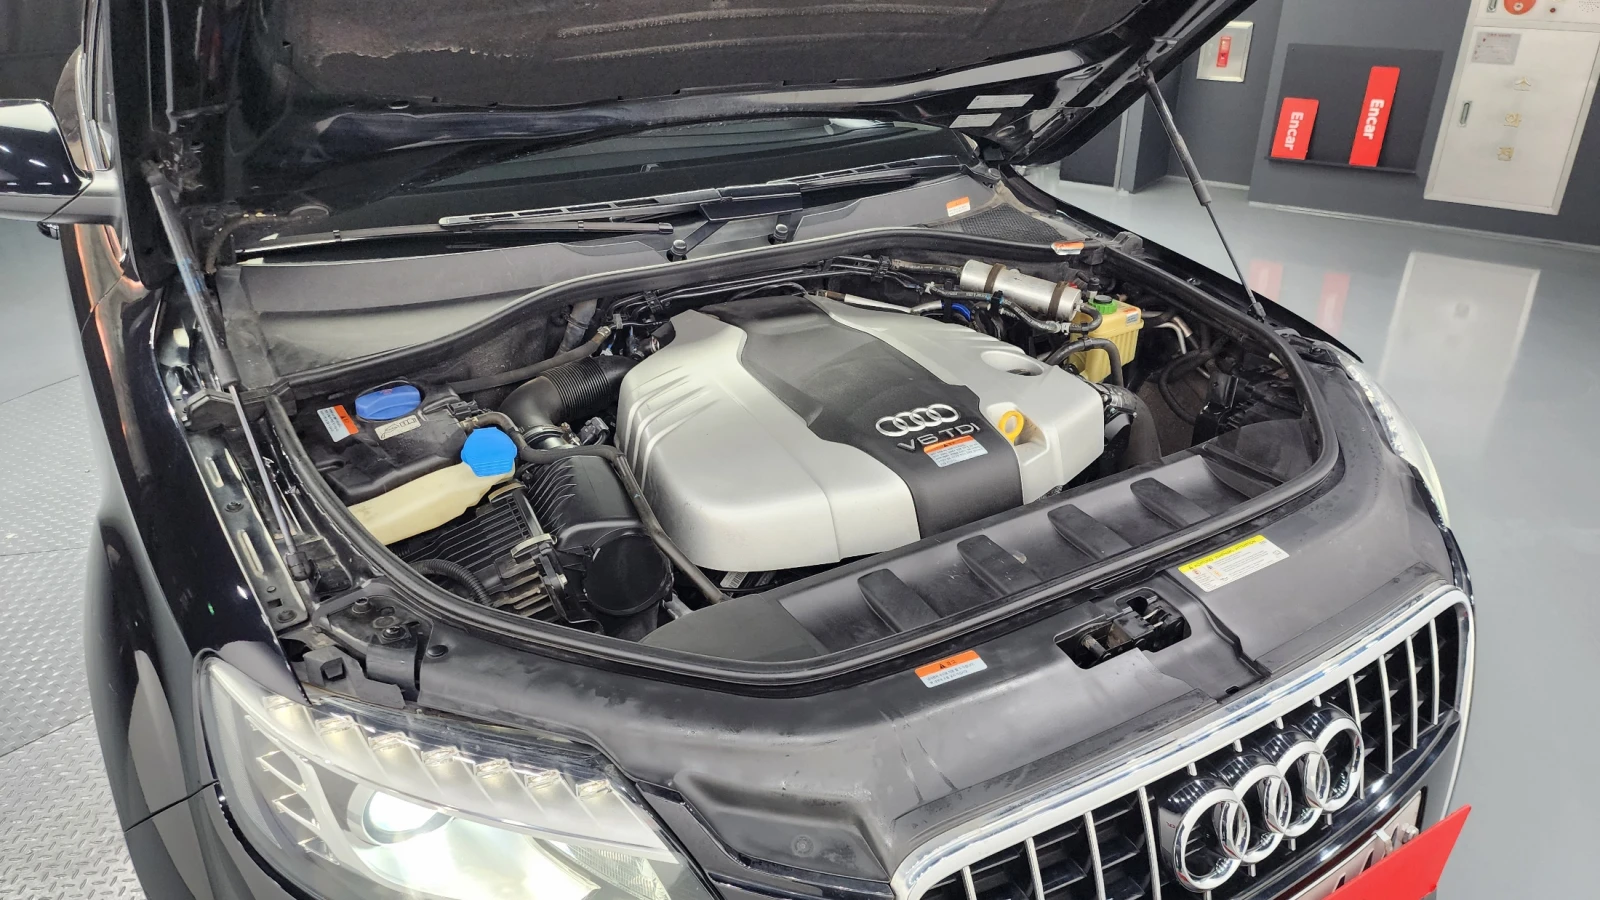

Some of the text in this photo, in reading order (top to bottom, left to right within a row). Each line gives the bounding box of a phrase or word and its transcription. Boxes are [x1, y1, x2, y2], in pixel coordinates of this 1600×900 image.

[1284, 112, 1304, 151] Encar
[1363, 99, 1385, 140] Encar
[897, 434, 939, 451] V6
[938, 422, 980, 437] TDI
